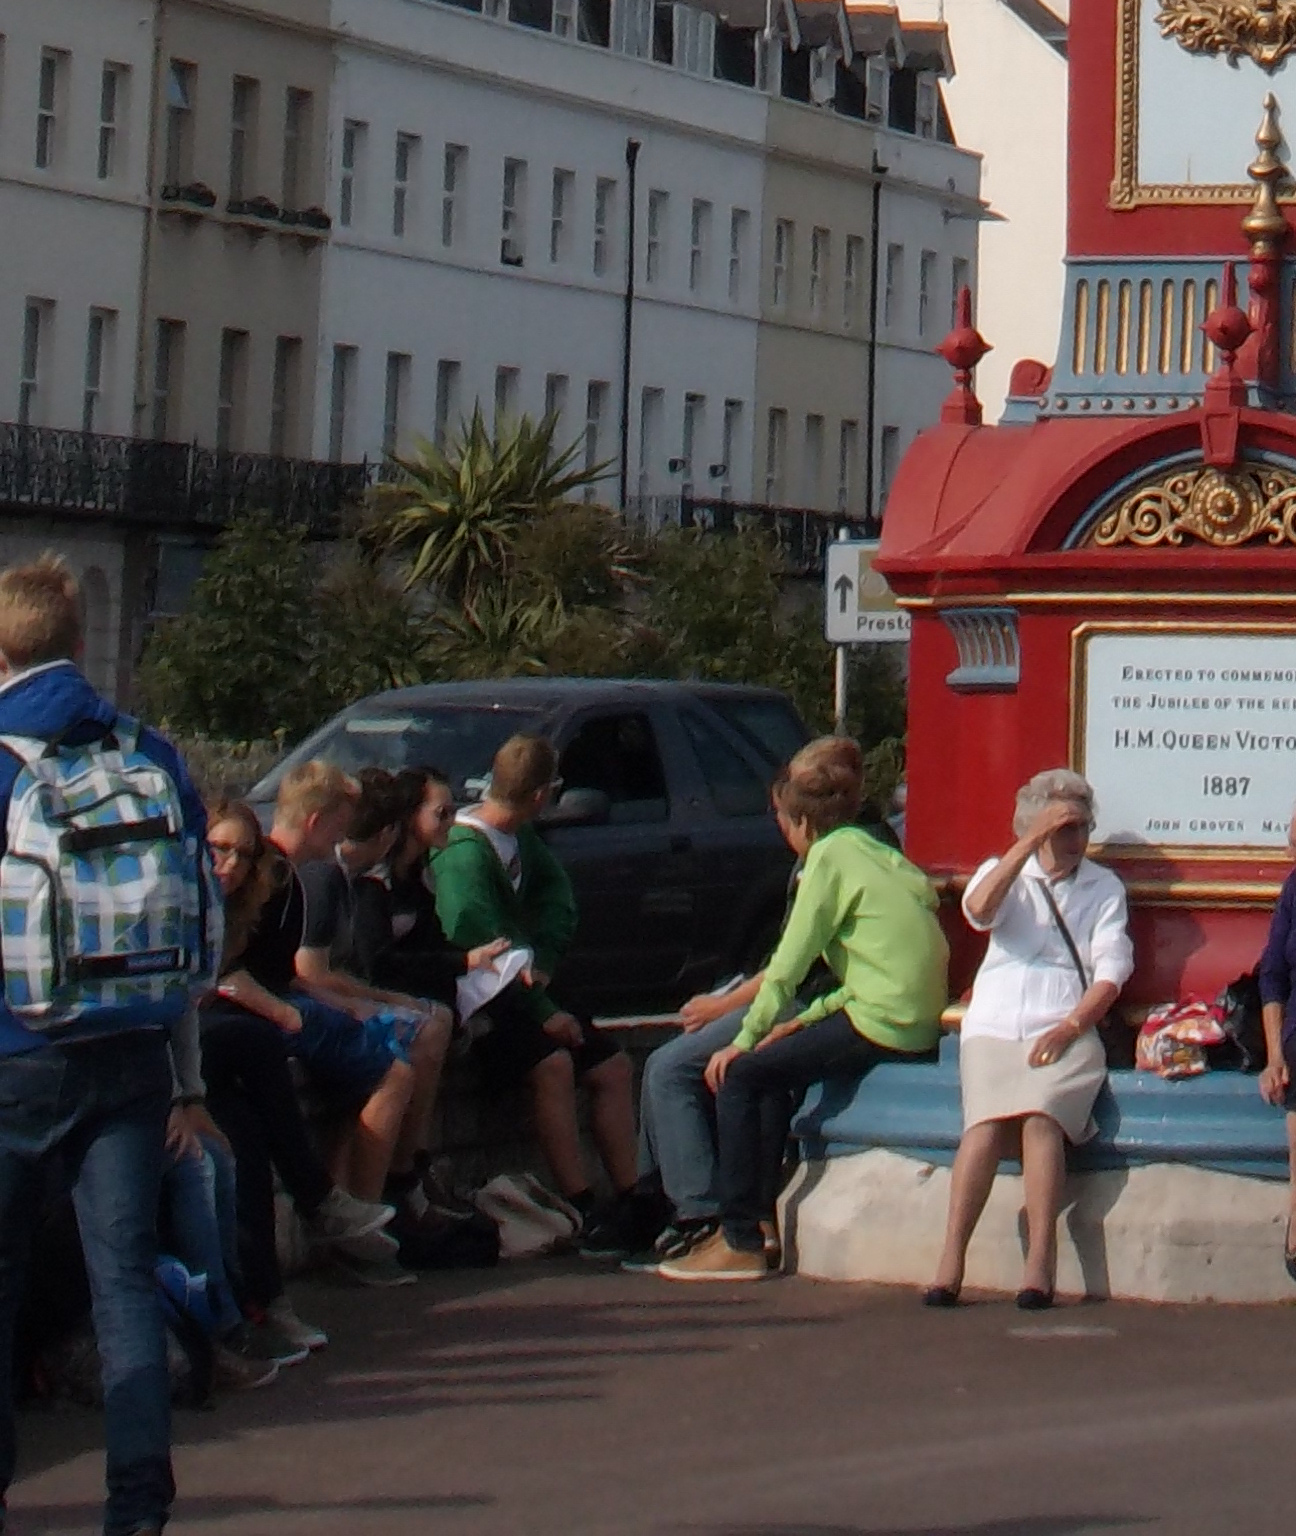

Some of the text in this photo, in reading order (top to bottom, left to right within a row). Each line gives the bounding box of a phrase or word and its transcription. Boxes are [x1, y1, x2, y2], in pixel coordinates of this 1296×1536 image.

[856, 615, 911, 631] Presto
[1121, 665, 1194, 682] ERECTED
[1196, 669, 1216, 682] TO
[1111, 695, 1142, 709] THE
[1146, 693, 1210, 710] JUBILEE
[1213, 697, 1232, 710] OF
[1236, 697, 1266, 710] THE
[1203, 775, 1252, 797] 1887
[1144, 818, 1181, 832] JOHN
[1261, 819, 1290, 833] MAY
